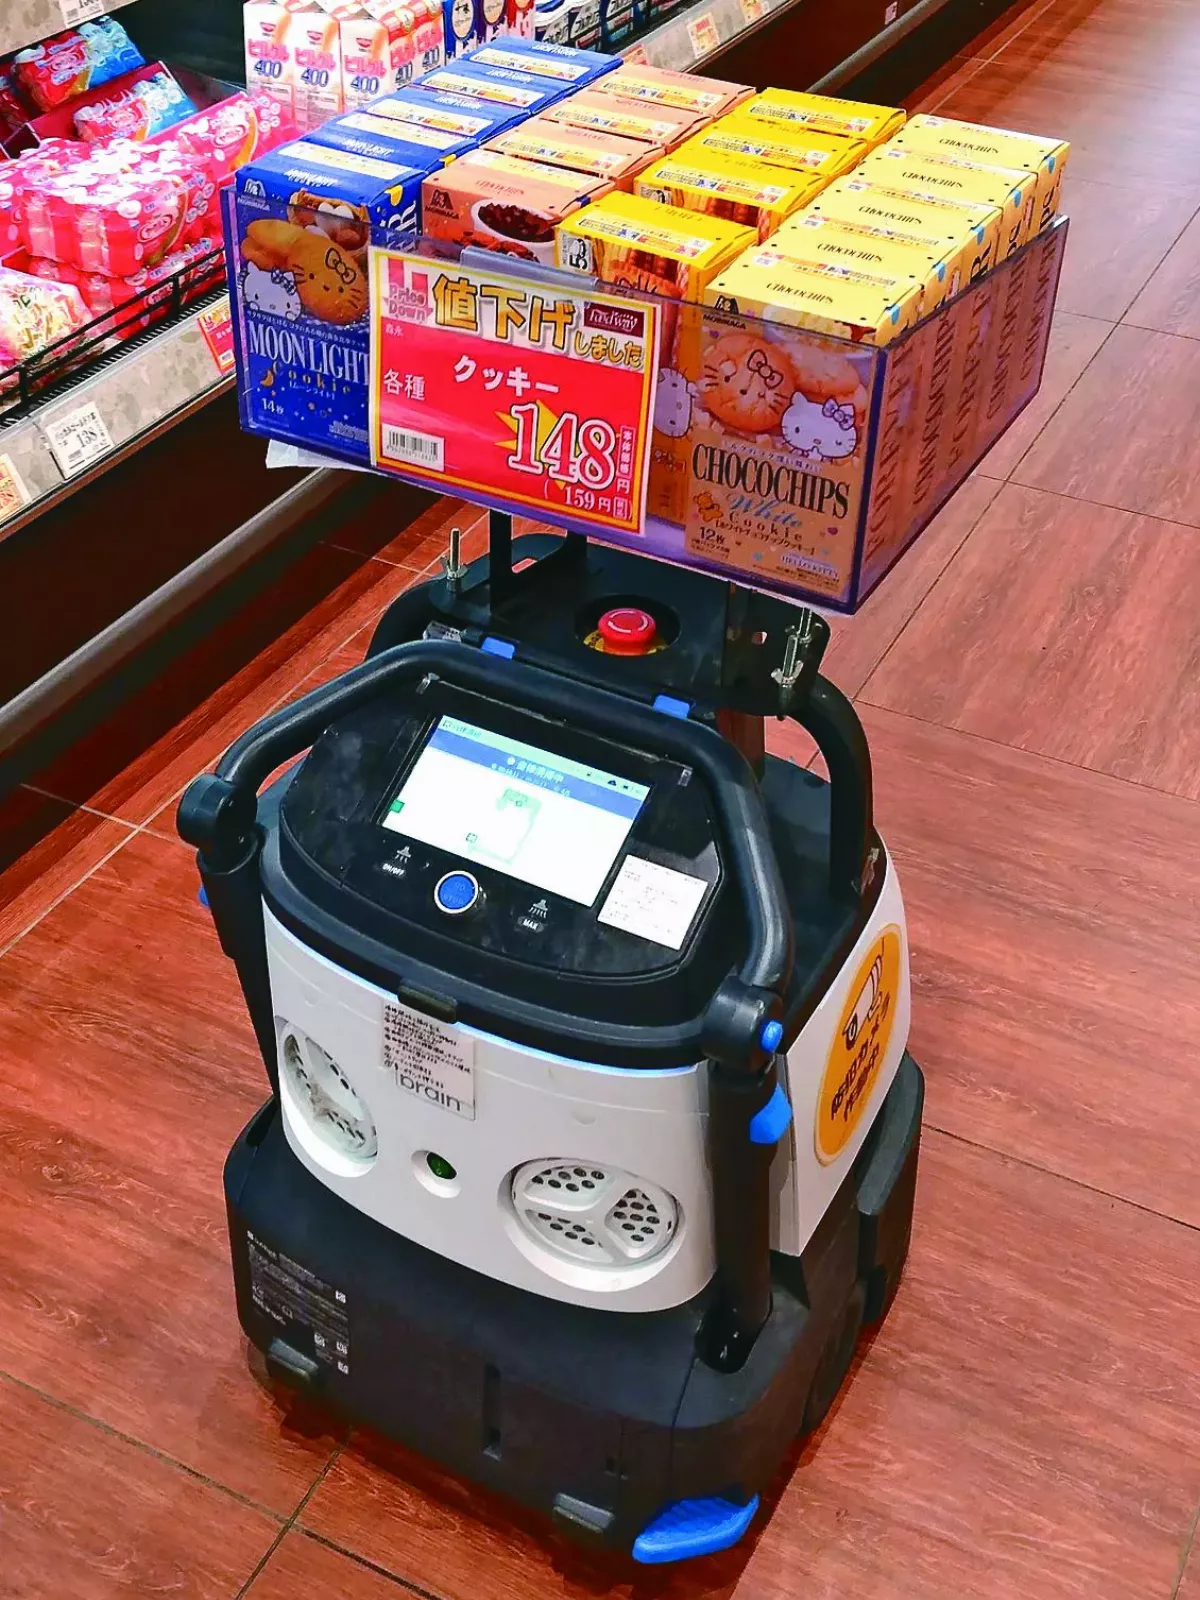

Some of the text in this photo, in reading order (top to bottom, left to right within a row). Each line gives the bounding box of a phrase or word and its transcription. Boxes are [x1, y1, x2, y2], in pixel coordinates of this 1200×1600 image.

[253, 59, 282, 79] 400
[300, 67, 329, 88] 400
[350, 75, 380, 95] 400
[389, 301, 427, 322] Down
[248, 320, 369, 386] MOONLIGHT
[272, 361, 350, 395] Cookie
[384, 368, 425, 401] 各種
[454, 355, 559, 397] クッキー
[508, 402, 616, 490] 148
[692, 443, 850, 519] CHOCOCHIPS
[726, 493, 802, 527] White
[729, 511, 802, 540] Cookie
[522, 918, 540, 931] MAX
